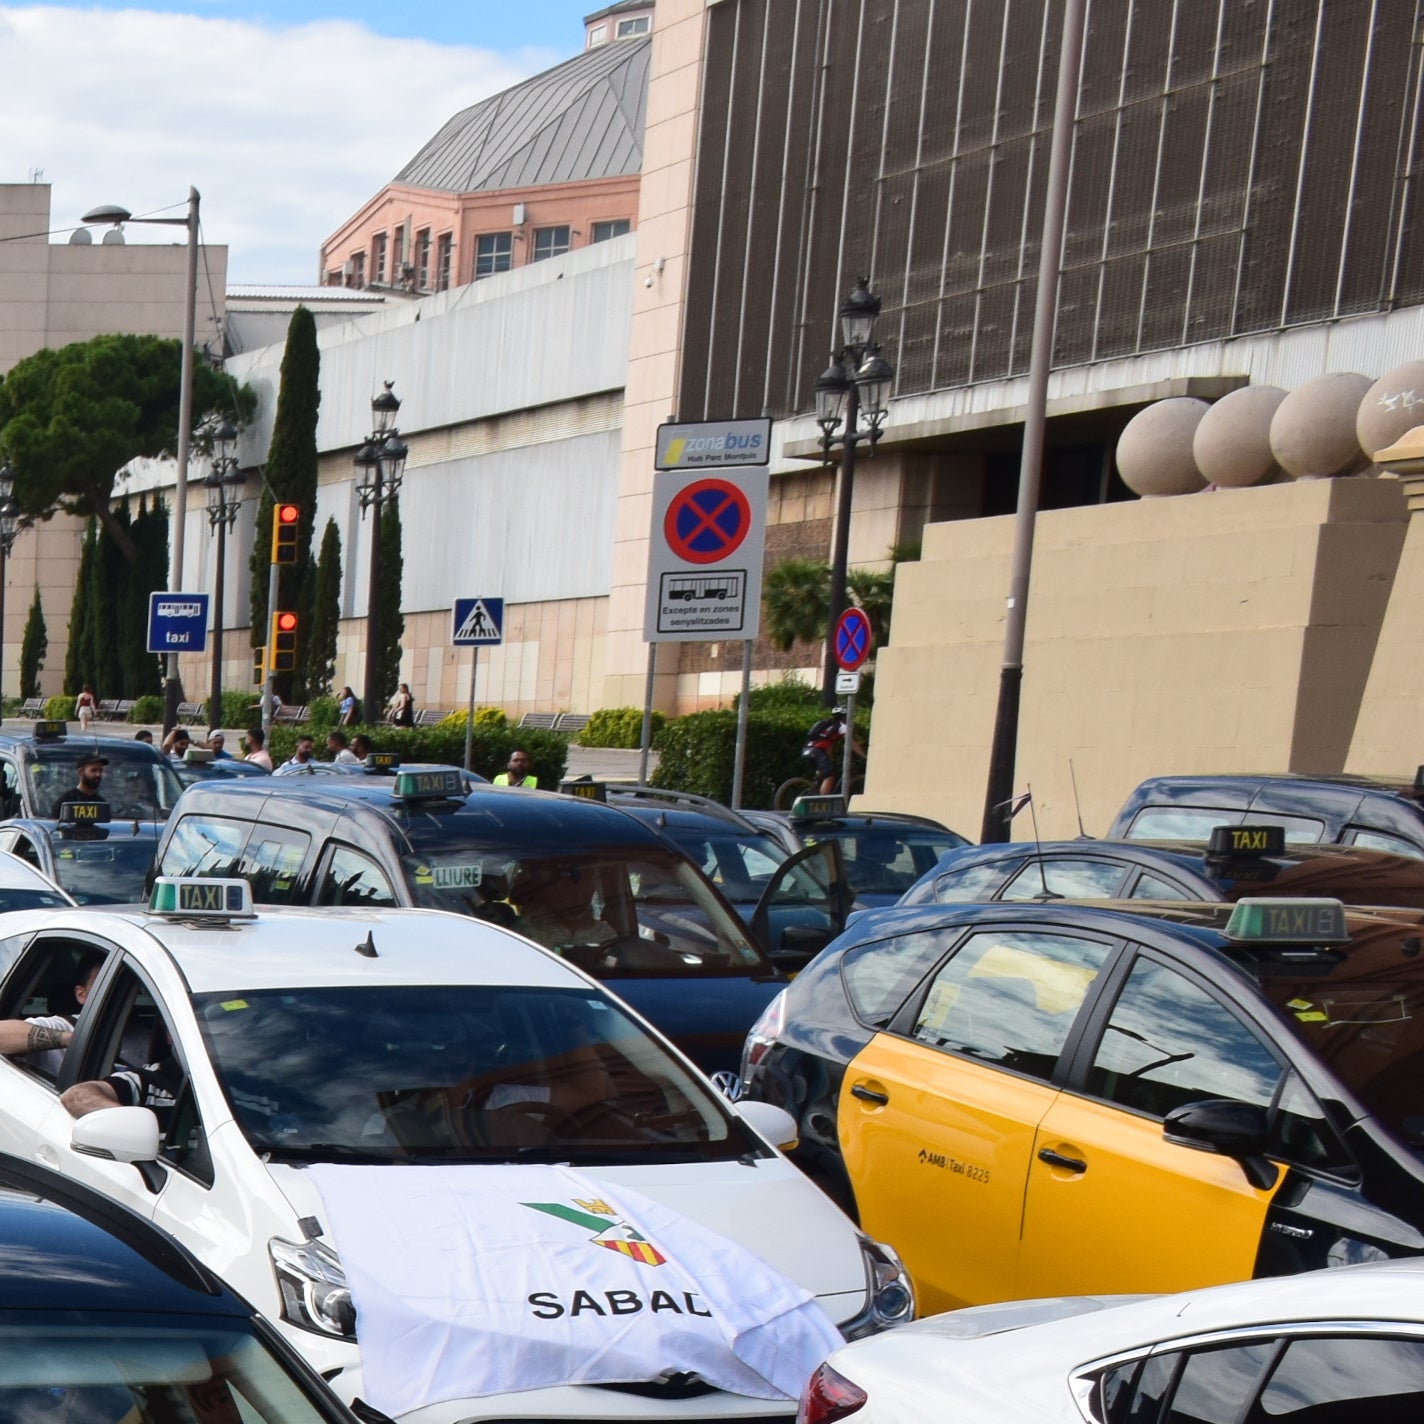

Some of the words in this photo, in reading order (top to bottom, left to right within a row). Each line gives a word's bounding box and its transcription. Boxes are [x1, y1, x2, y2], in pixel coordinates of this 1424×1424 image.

[685, 431, 761, 451] zonabus
[705, 454, 721, 462] Parc
[662, 606, 697, 616] Excepte
[699, 606, 710, 614] en
[713, 605, 739, 613] zones
[670, 617, 730, 627] senyalitzades
[165, 631, 190, 643] taxi
[375, 756, 392, 765] TAXI
[415, 775, 444, 790] TAXI
[574, 786, 596, 798] TAXI
[72, 805, 97, 819] TAXI
[1232, 831, 1269, 849] TAXI
[435, 866, 480, 887] LLIURE
[182, 885, 223, 909] TAXI
[1269, 909, 1313, 935] TAXI
[928, 1152, 946, 1168] AMB
[949, 1159, 966, 1175] Taxi
[967, 1165, 990, 1184] 8225
